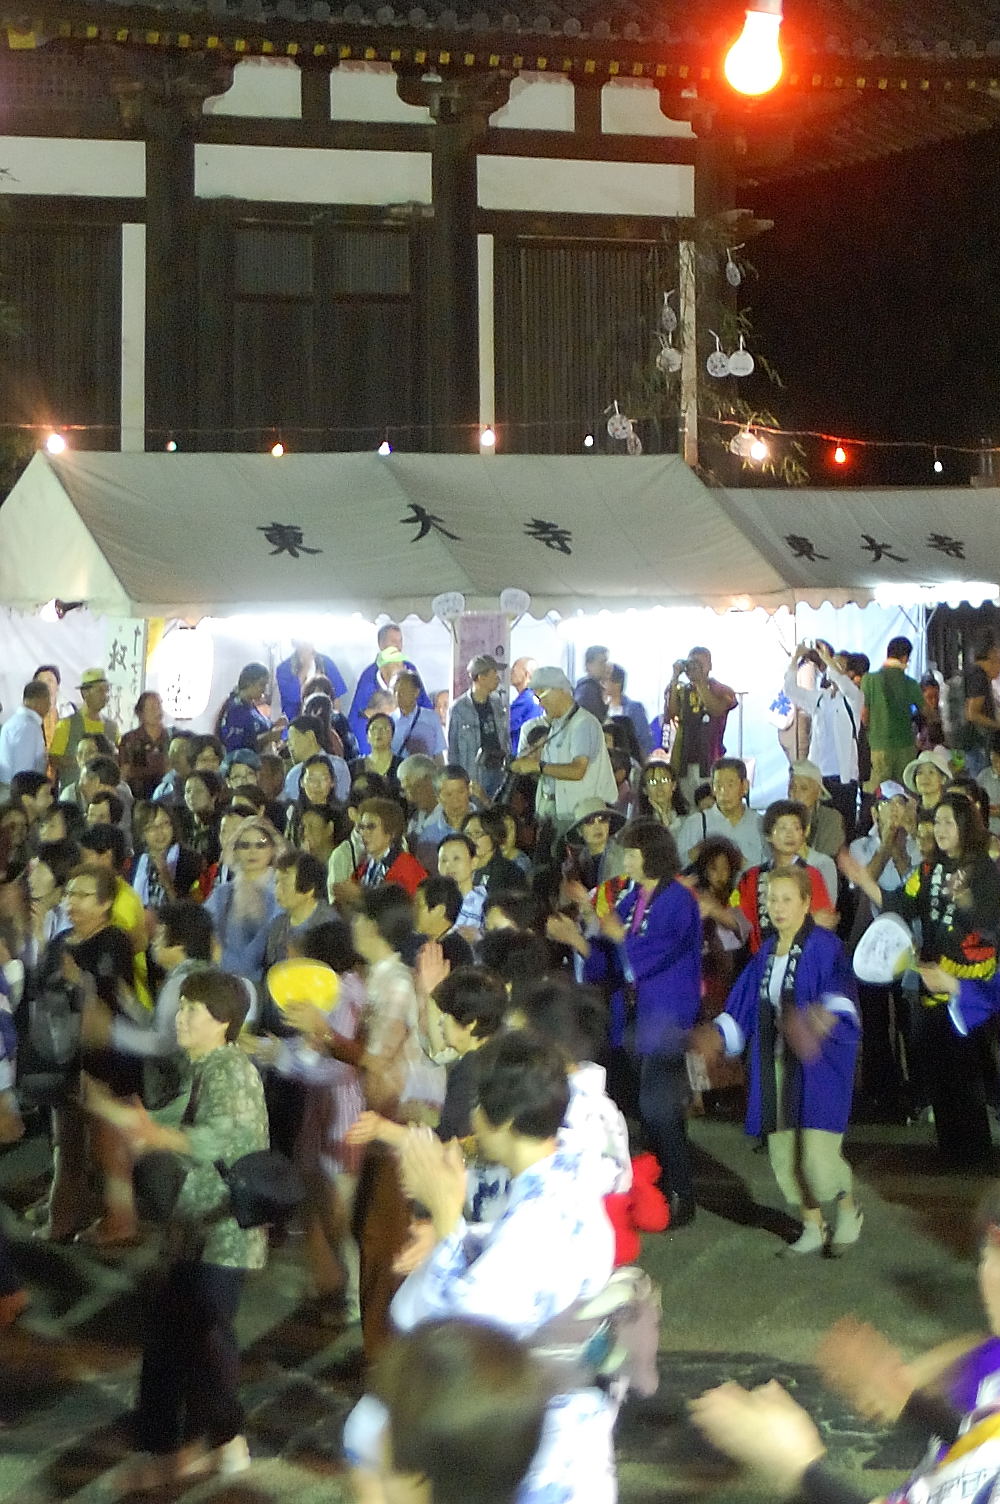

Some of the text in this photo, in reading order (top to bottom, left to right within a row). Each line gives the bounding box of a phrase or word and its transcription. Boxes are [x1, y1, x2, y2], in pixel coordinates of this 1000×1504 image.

[256, 503, 572, 558] 東大寺
[784, 532, 966, 562] 東大寺
